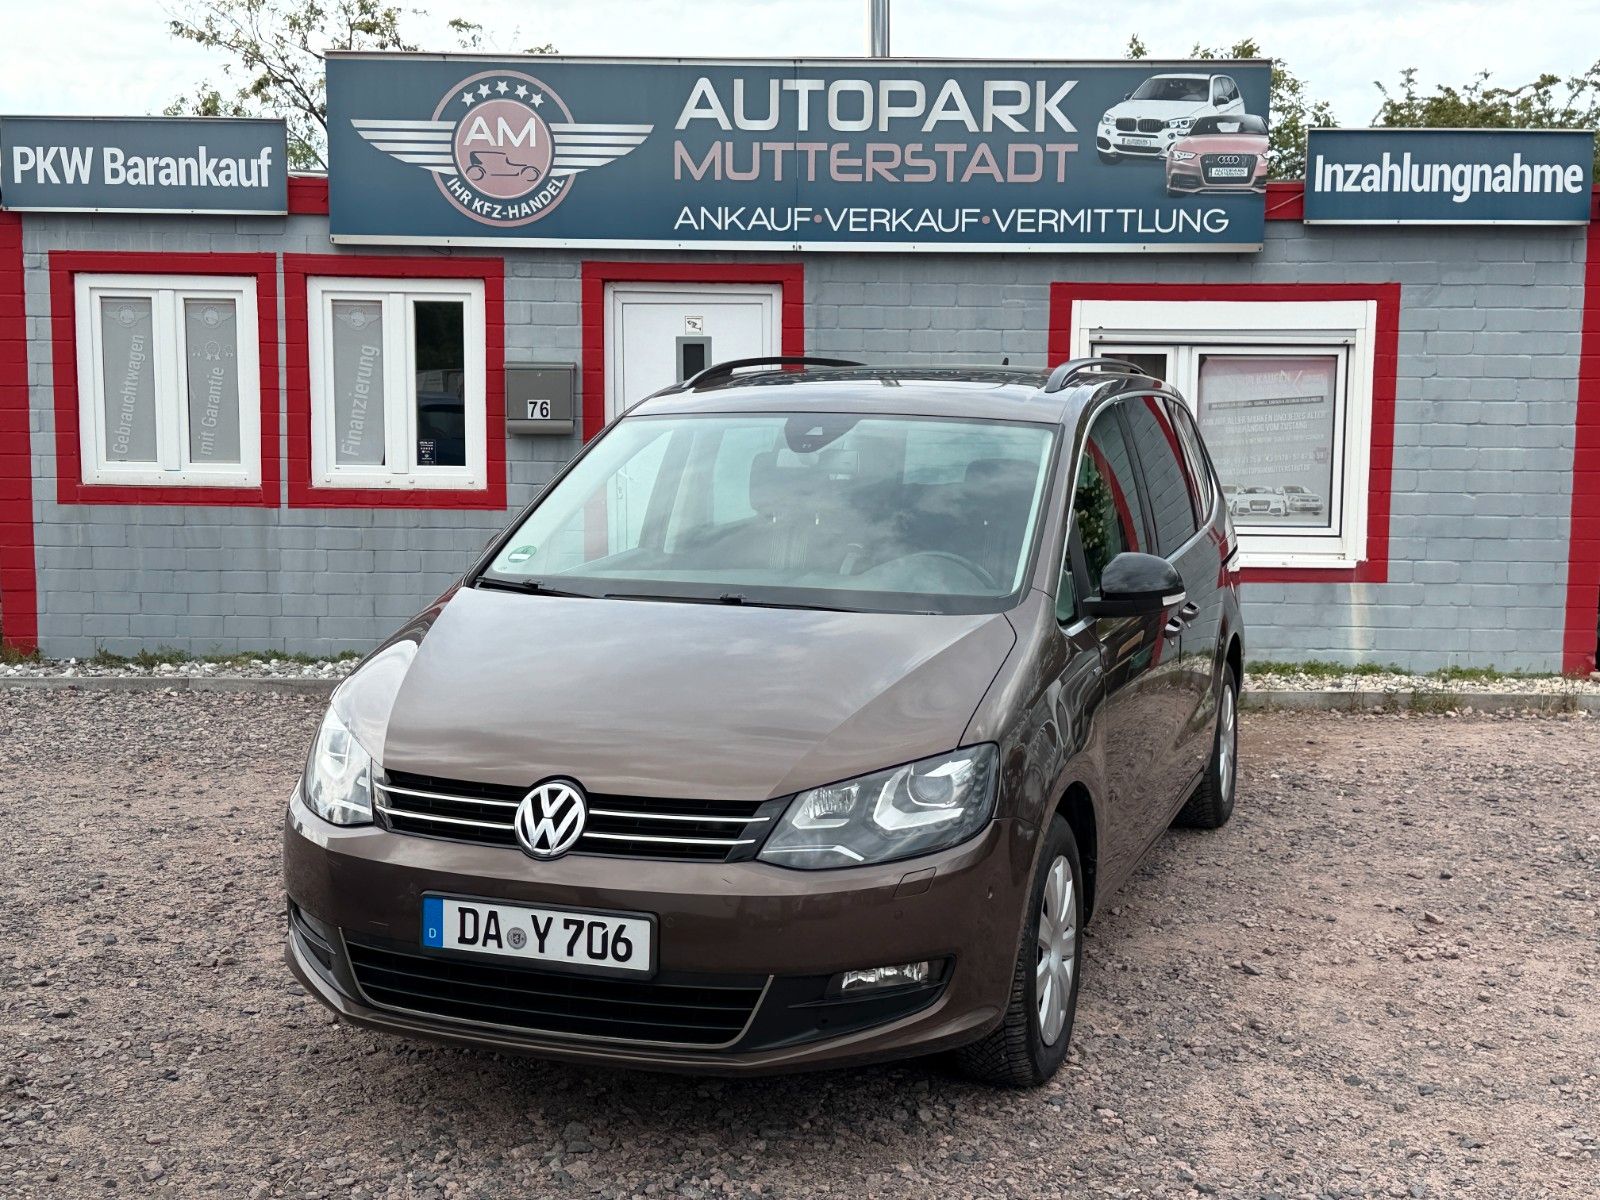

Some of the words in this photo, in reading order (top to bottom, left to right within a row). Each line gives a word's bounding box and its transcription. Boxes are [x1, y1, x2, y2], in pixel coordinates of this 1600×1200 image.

[674, 77, 1079, 132] AUTOPARK
[463, 116, 536, 147] AM
[13, 146, 93, 184] PKW
[103, 146, 272, 187] Barankauf
[674, 140, 1079, 182] MUTTERSTADT
[1314, 152, 1583, 203] Inzahlungnahme
[447, 177, 473, 205] IHR
[472, 178, 566, 219] KFZ-HANDEL
[674, 206, 813, 232] ANKAUF
[824, 207, 981, 233] VERKAUF
[992, 208, 1230, 234] VERMITTLUNG
[113, 335, 145, 454] Gebrauchtwagen
[201, 367, 225, 428] Garantie
[341, 344, 381, 456] Finanzierung
[528, 402, 550, 418] 76
[198, 431, 215, 456] mit
[515, 783, 586, 854] VW
[428, 926, 437, 938] D
[457, 906, 503, 948] DA
[531, 914, 553, 953] Y
[563, 918, 633, 962] 706
